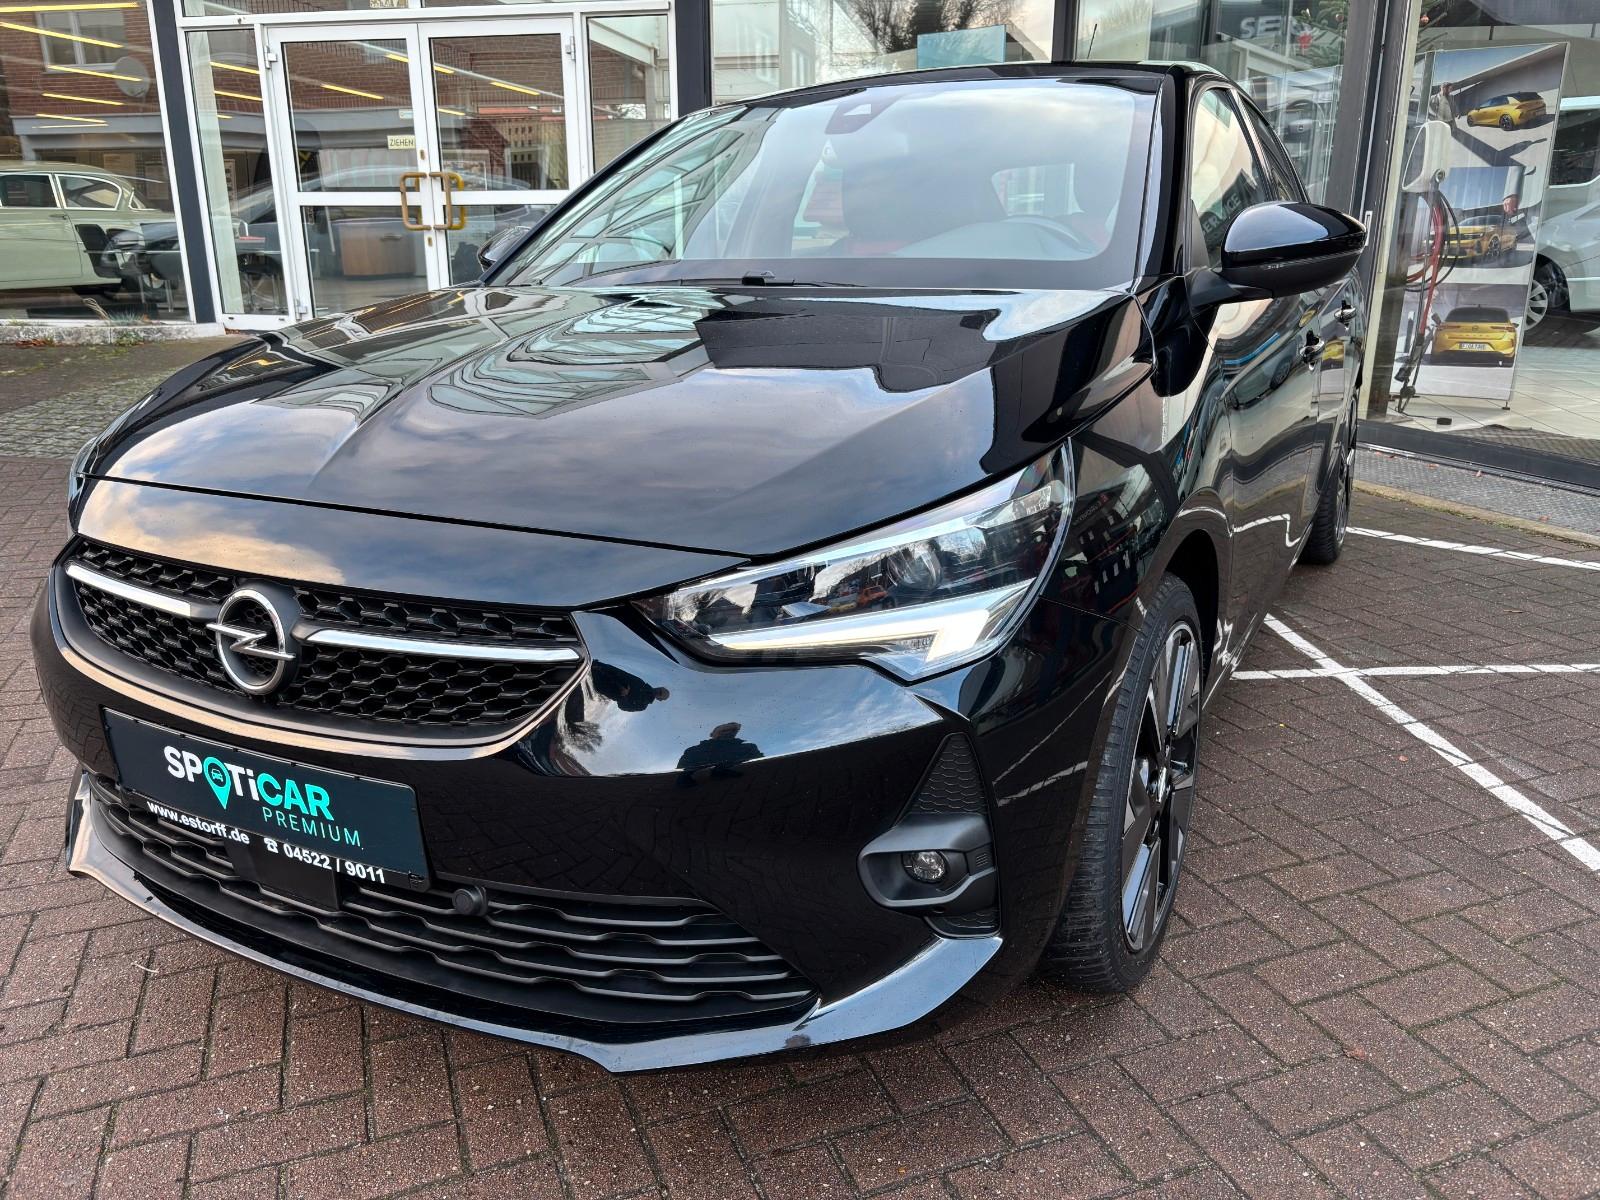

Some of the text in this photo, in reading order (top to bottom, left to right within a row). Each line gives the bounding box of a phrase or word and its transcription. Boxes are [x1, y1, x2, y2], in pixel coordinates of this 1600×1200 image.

[389, 138, 414, 147] ZIEHEN
[146, 801, 250, 845] www.estorff.de
[283, 843, 332, 870] 04522
[344, 861, 386, 884] 9011
[262, 806, 361, 847] PREMIUM
